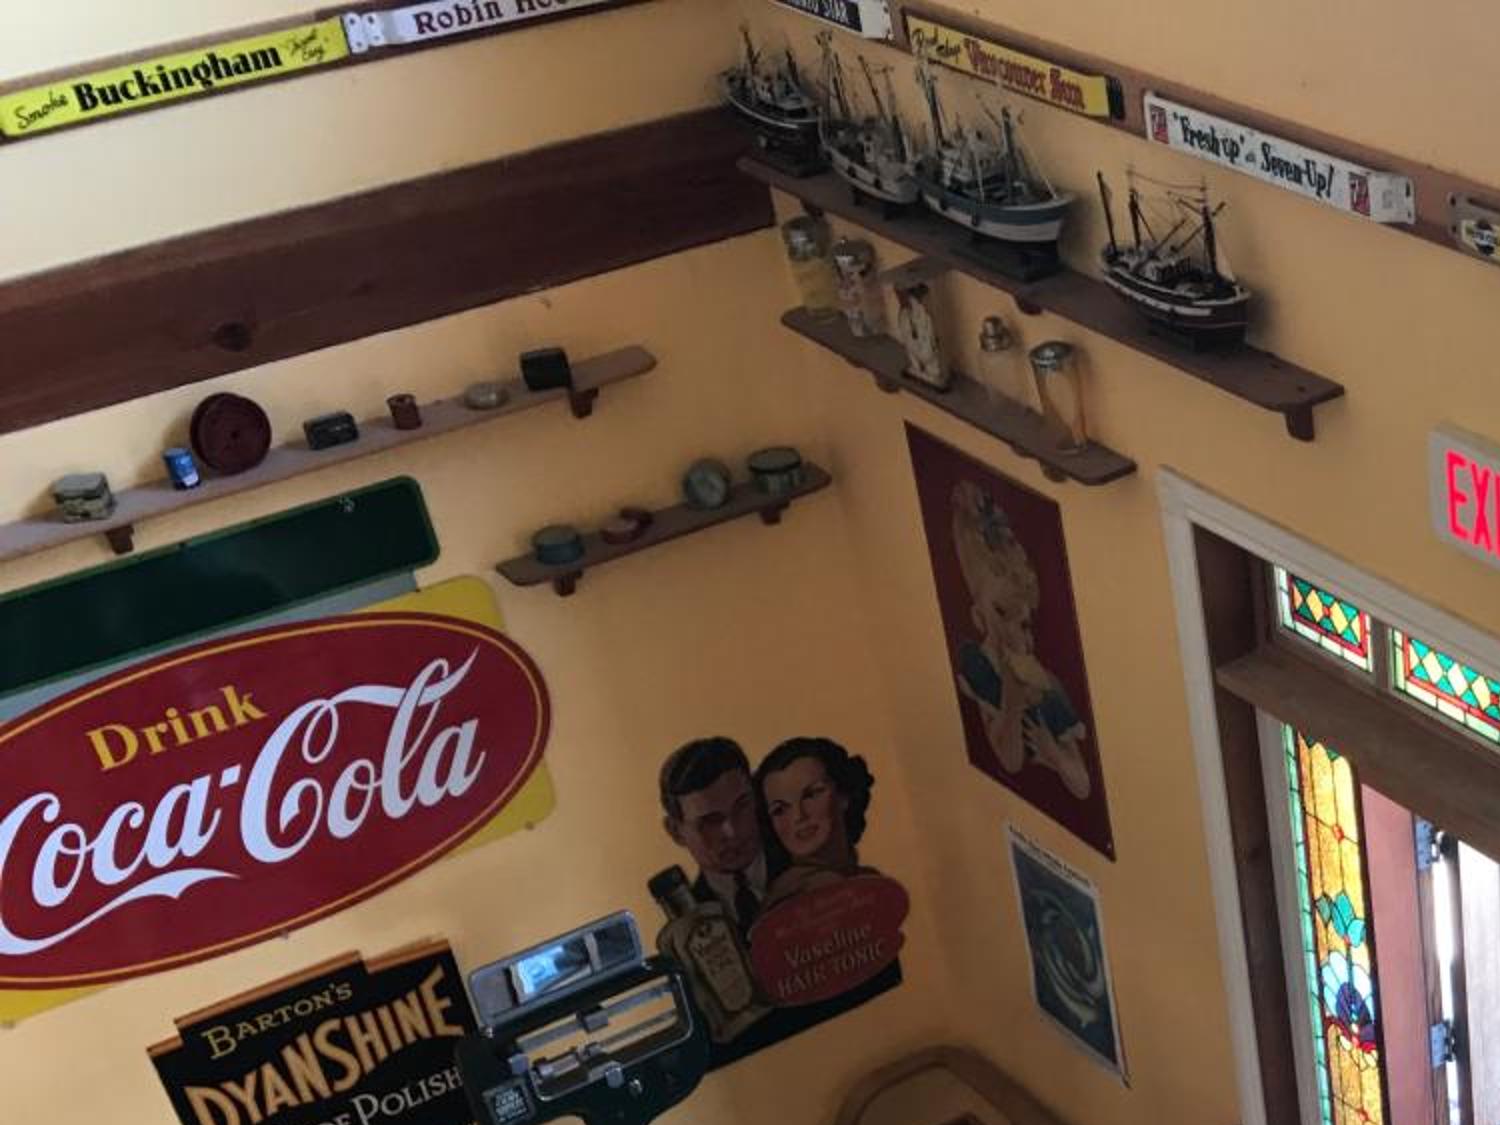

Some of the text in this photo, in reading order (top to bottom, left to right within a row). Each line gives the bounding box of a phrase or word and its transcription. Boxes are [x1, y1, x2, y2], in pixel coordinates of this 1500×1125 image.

[413, 1, 504, 34] Robin
[15, 90, 69, 129] Smoke
[72, 46, 283, 112] Buckingham
[963, 37, 1085, 110] Vancouver Sun
[1261, 141, 1335, 199] Seven-Up!
[86, 685, 268, 770] Drink
[0, 645, 486, 955] Coca-Cola
[202, 982, 353, 1061] BARTON'S
